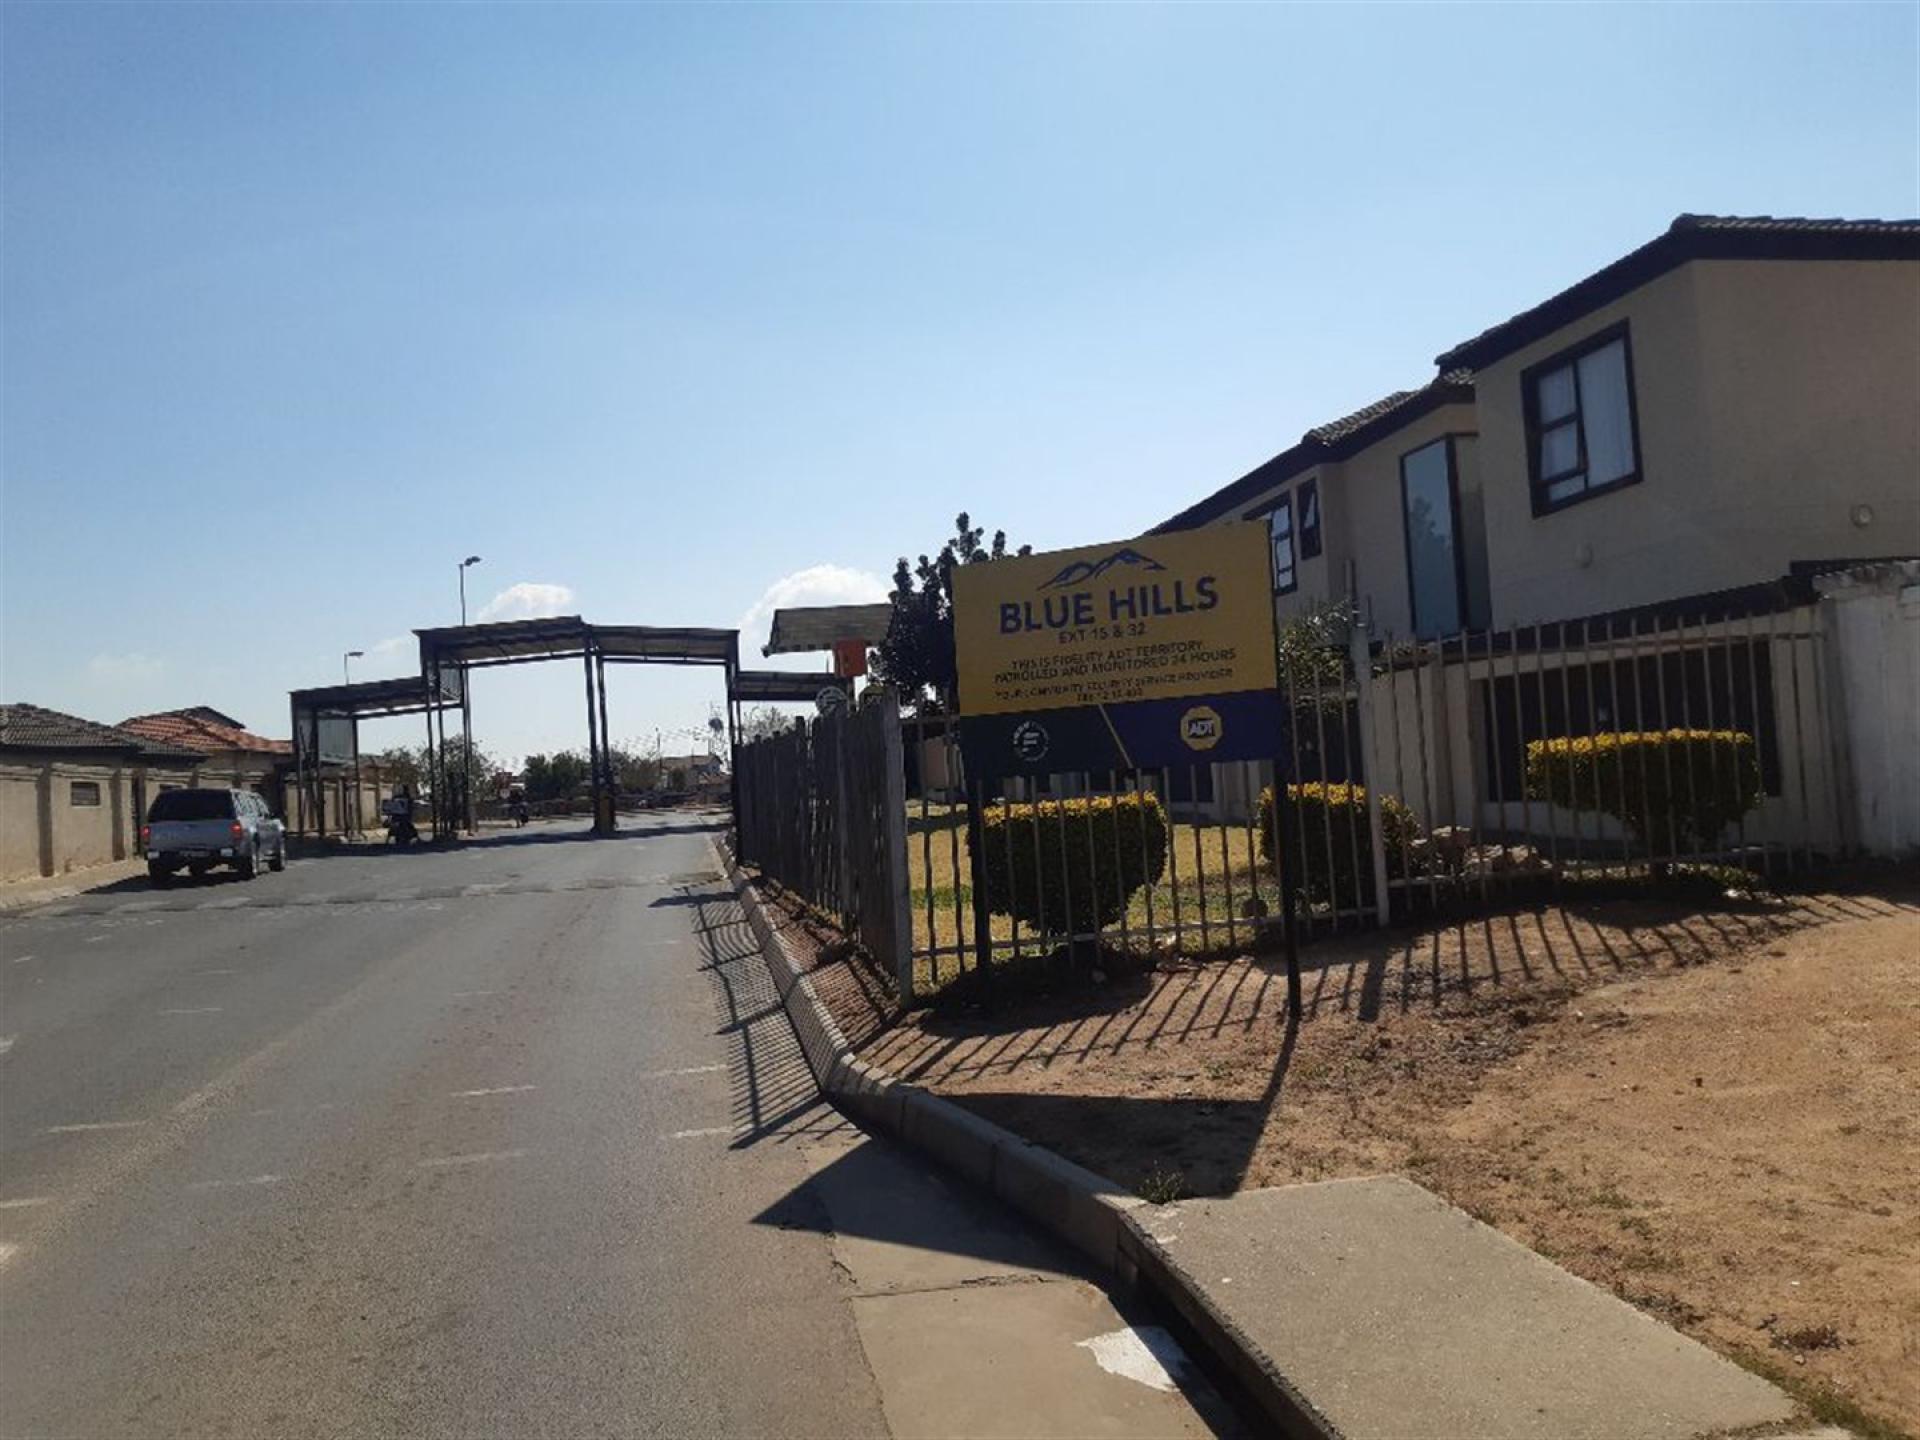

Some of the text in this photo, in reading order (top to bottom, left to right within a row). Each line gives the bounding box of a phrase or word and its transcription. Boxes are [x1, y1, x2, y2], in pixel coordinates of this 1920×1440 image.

[1000, 576, 1218, 634] BLUE HILLS
[1059, 622, 1146, 644] EXT 15 & 32
[994, 648, 1237, 683] PATROLLED AND MONITORED 24 HOURS
[1011, 639, 1202, 670] THIS IS FIDELITY ADT TERRITORY
[1189, 720, 1213, 736] ADT
